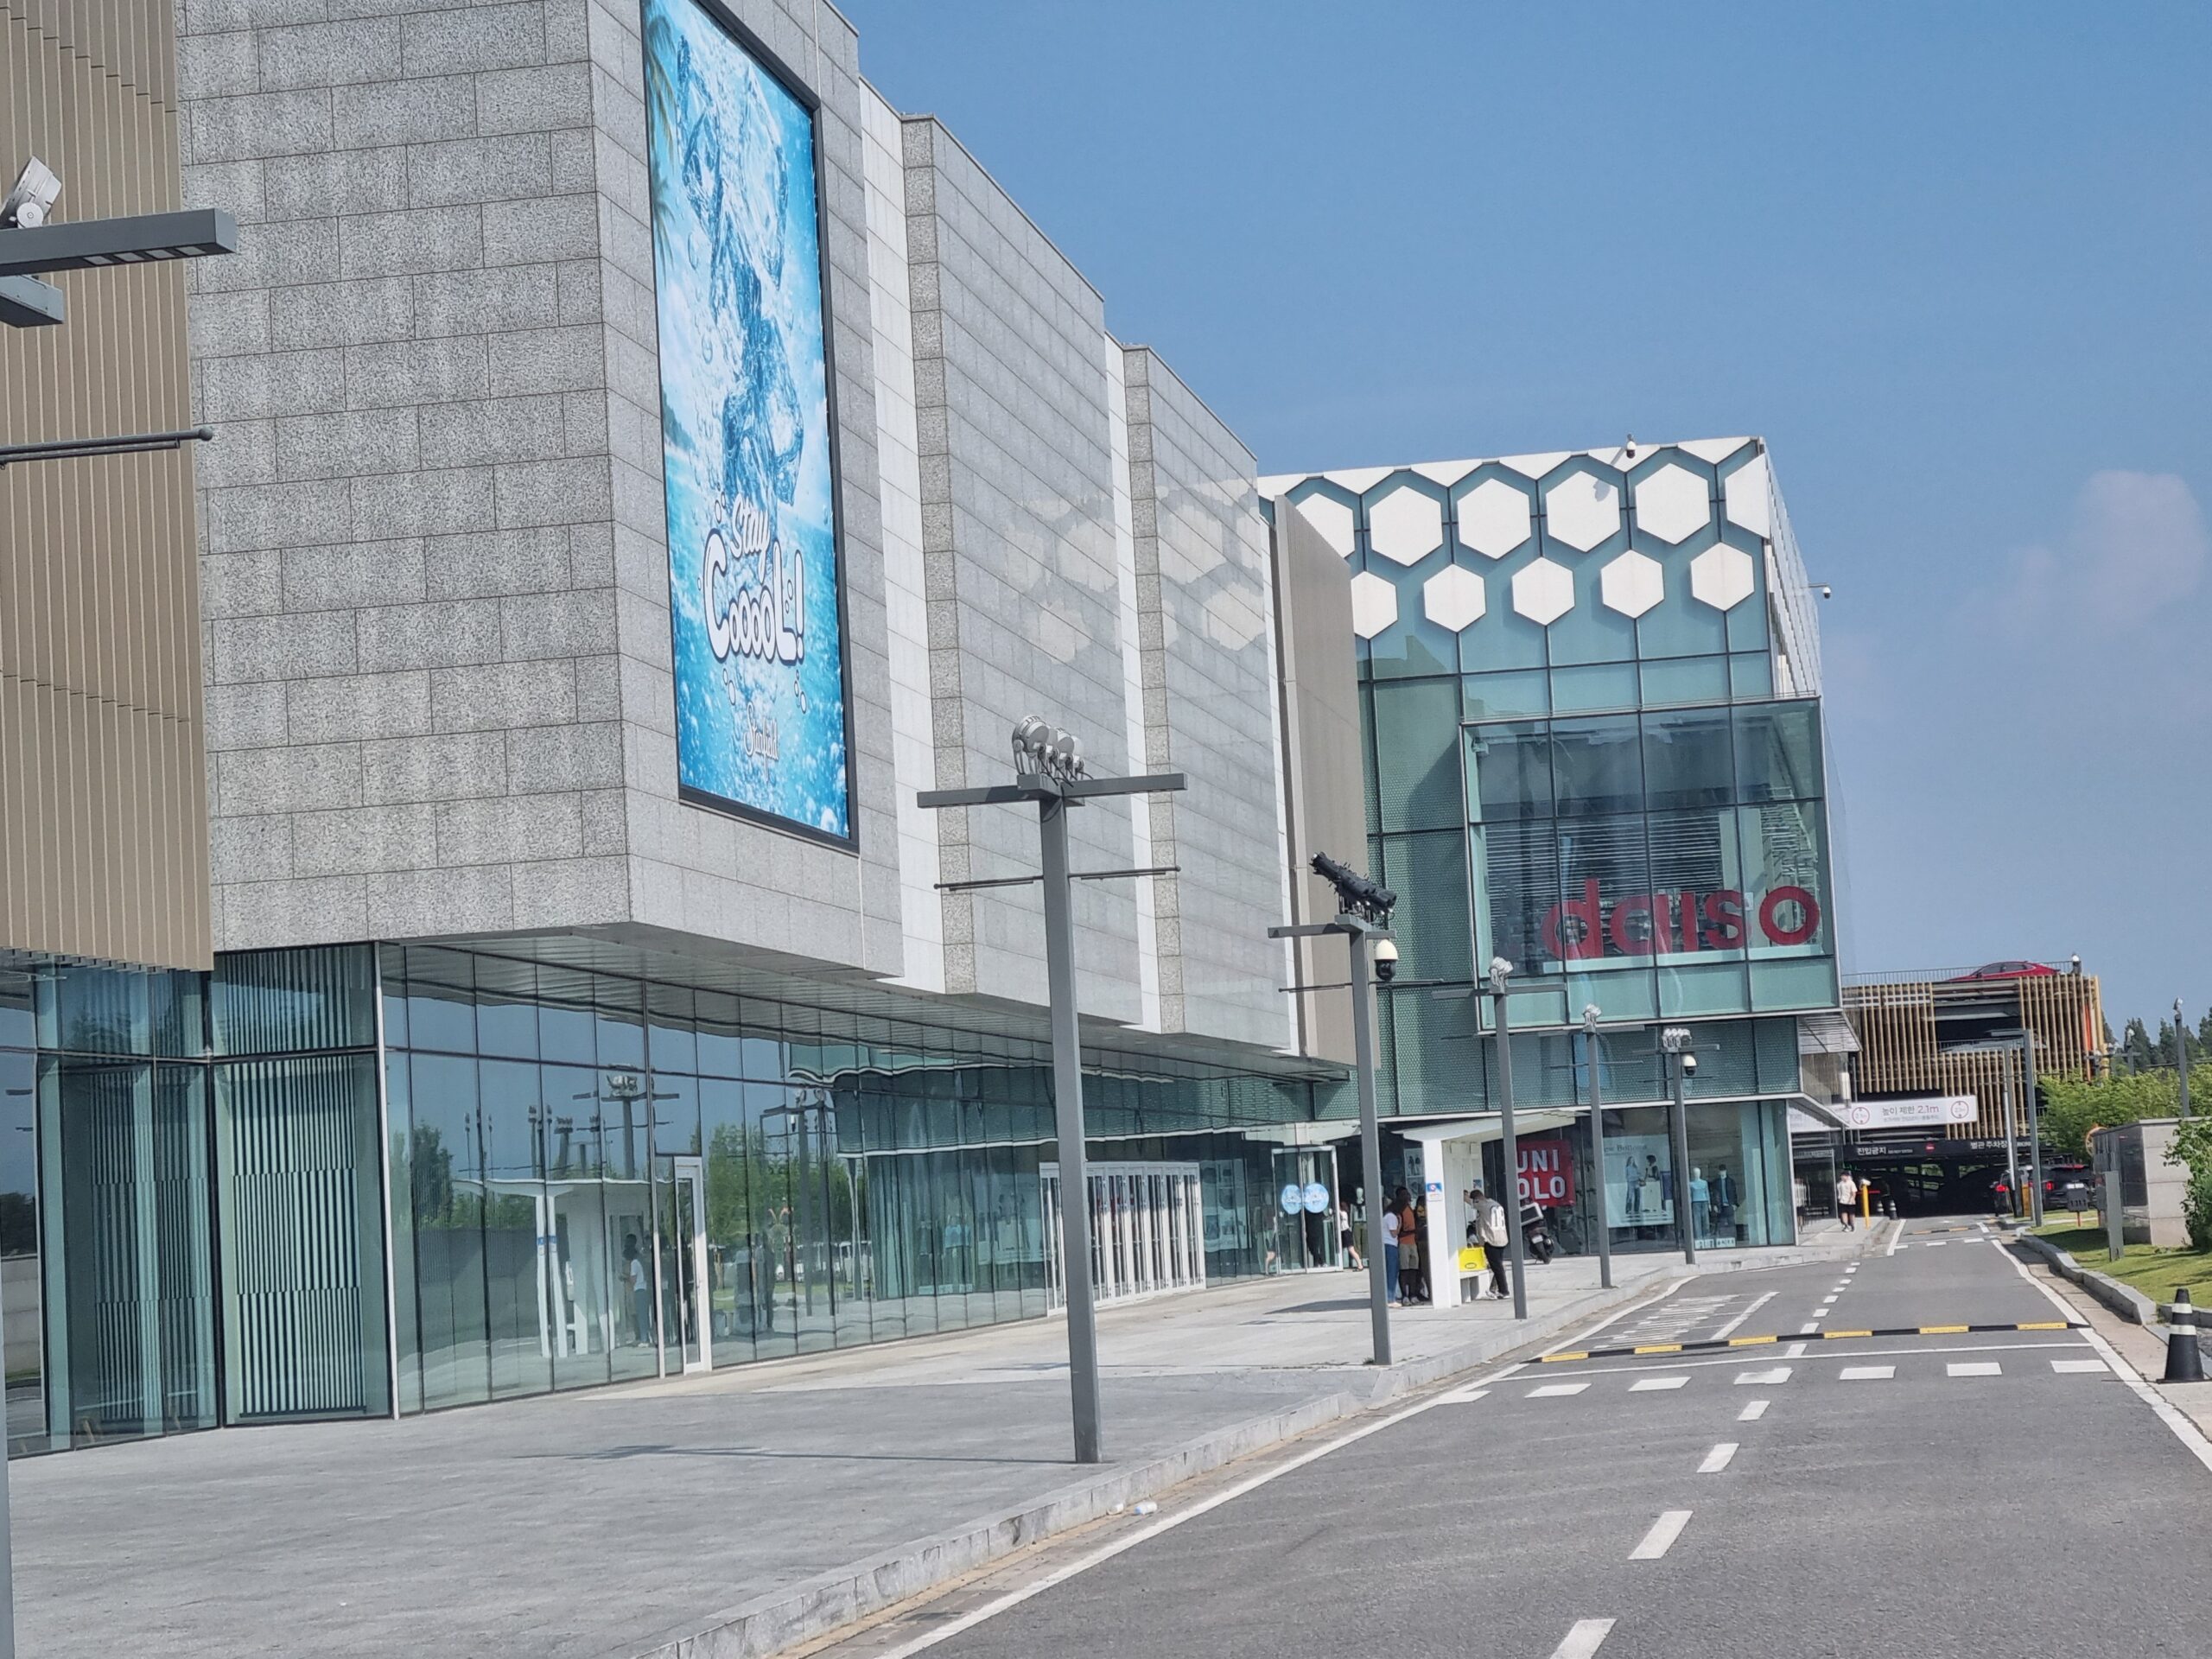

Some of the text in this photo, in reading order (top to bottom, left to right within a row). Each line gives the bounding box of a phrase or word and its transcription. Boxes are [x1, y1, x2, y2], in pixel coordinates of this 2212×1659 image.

[730, 493, 770, 586] Stay
[1541, 878, 1821, 960] daiso
[1917, 1105, 1940, 1114] 2.1m
